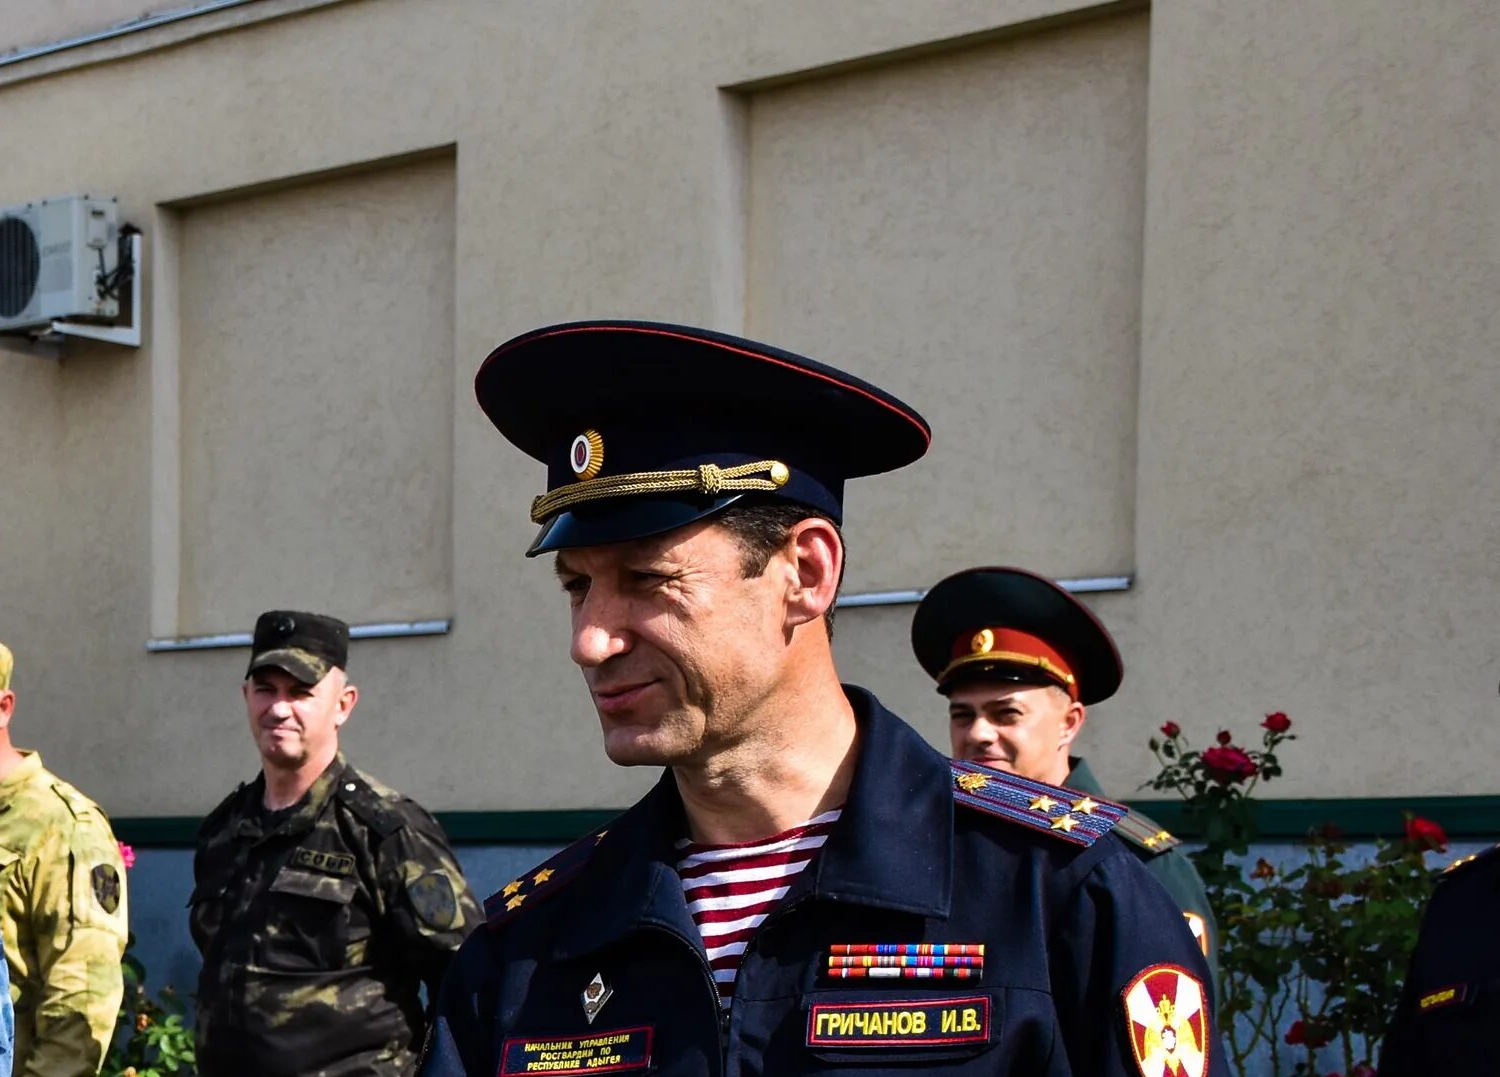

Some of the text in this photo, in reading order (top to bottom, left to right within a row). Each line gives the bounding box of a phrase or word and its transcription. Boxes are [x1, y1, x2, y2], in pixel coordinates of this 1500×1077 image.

[815, 1008, 981, 1036] ГРИЧАНОВ И.В.
[525, 1034, 630, 1052] НАЧАЛЬНИК УПРАВЛЕНИЯ
[540, 1046, 611, 1061] РОСГВАРДИИ ПО
[527, 1055, 621, 1071] РЕСПУБЛИКЕ АДЫГЕЯ
